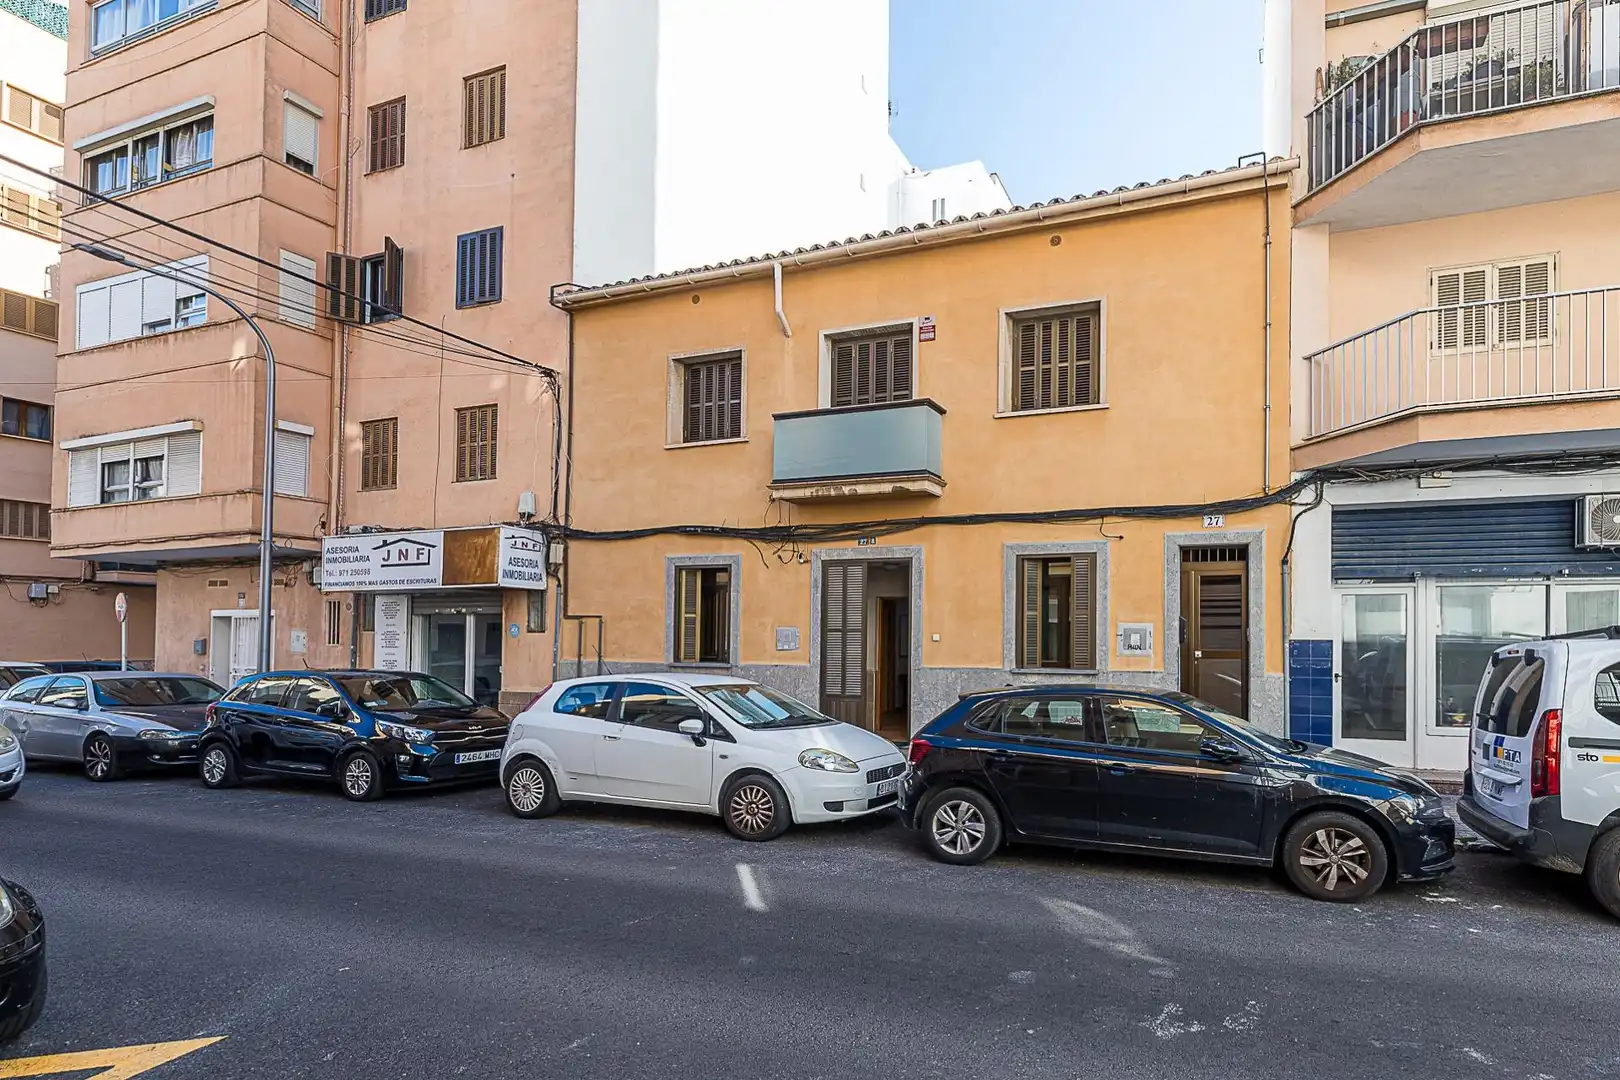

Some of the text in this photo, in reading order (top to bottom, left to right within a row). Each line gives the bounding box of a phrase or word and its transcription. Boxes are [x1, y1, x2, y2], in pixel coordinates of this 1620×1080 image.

[1207, 516, 1220, 526] 27
[325, 545, 360, 555] ASESORIA
[325, 555, 371, 565] INMOBILIARIA
[508, 556, 539, 569] ASESORIA
[339, 569, 349, 577] 971
[502, 568, 543, 582] INMOBILIARIA
[406, 577, 437, 585] ESCRITURAS
[461, 751, 499, 762] 2464 MHC
[1576, 752, 1599, 762] sto
